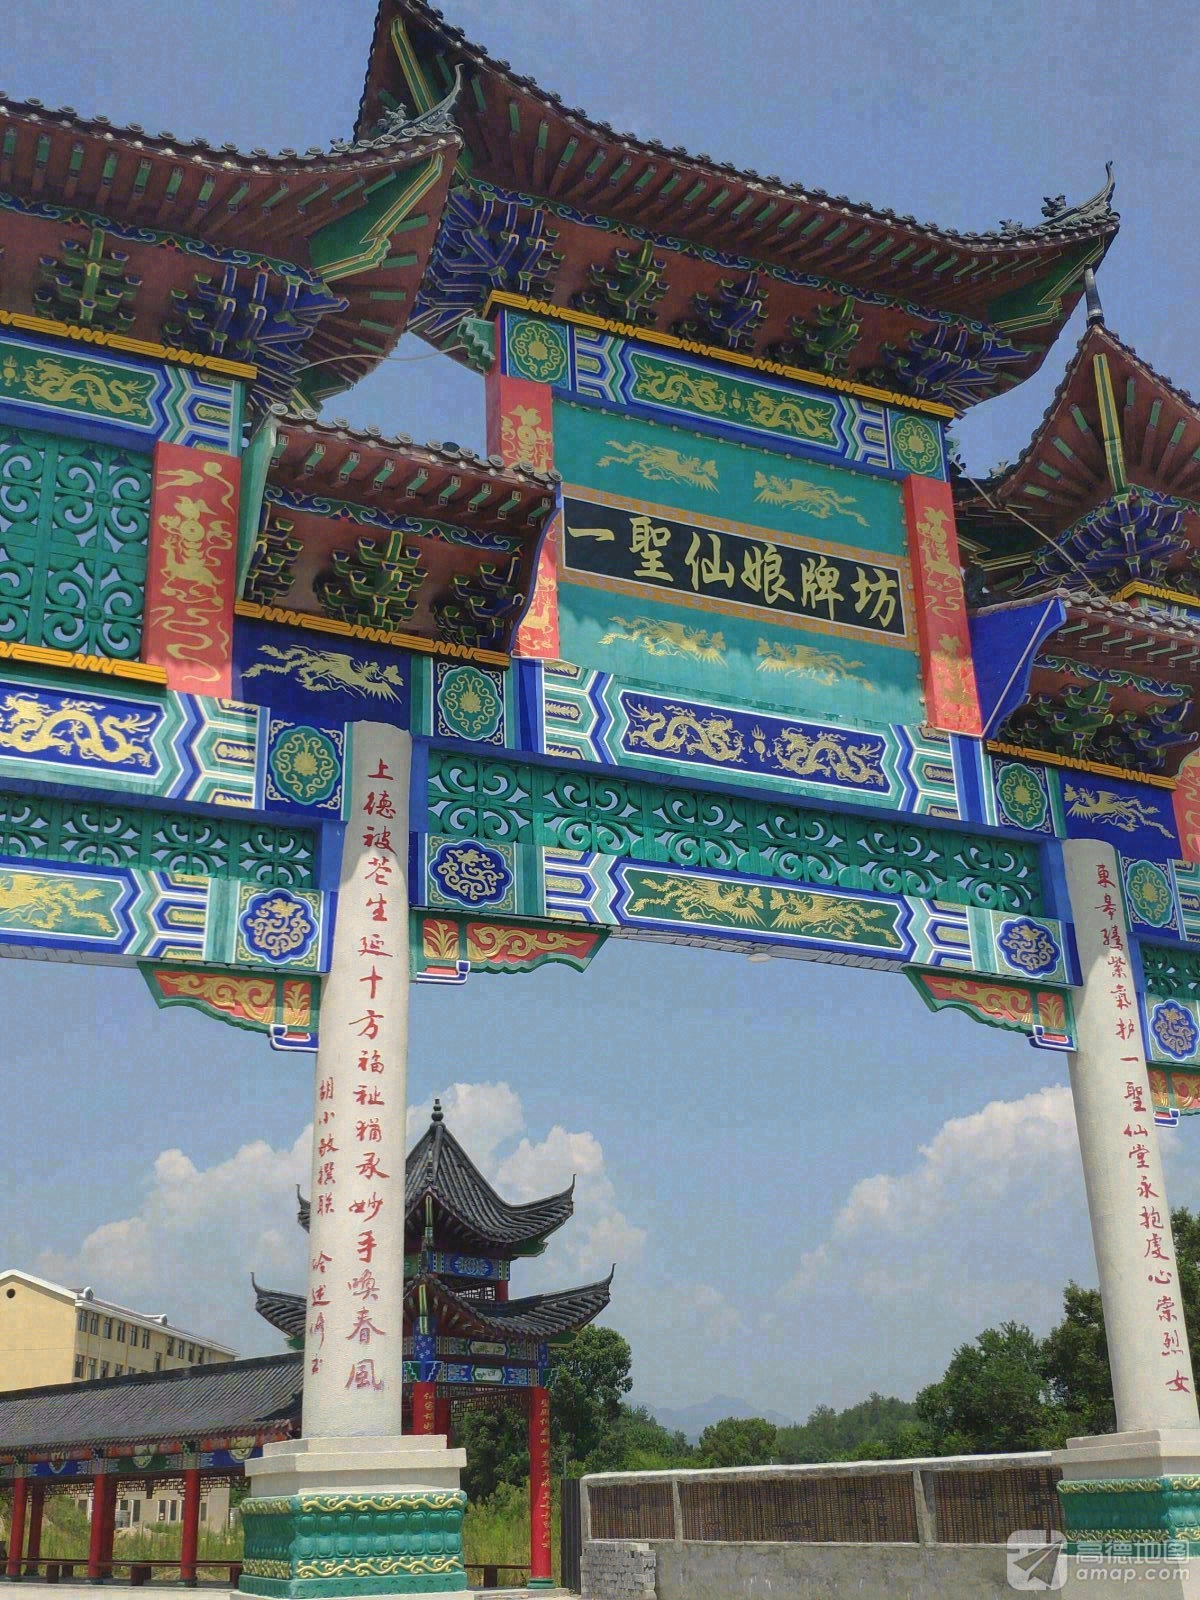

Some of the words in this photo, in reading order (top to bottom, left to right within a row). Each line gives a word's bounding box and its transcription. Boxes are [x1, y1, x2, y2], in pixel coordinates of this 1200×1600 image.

[567, 516, 899, 628] 一聖仙娘牌坊
